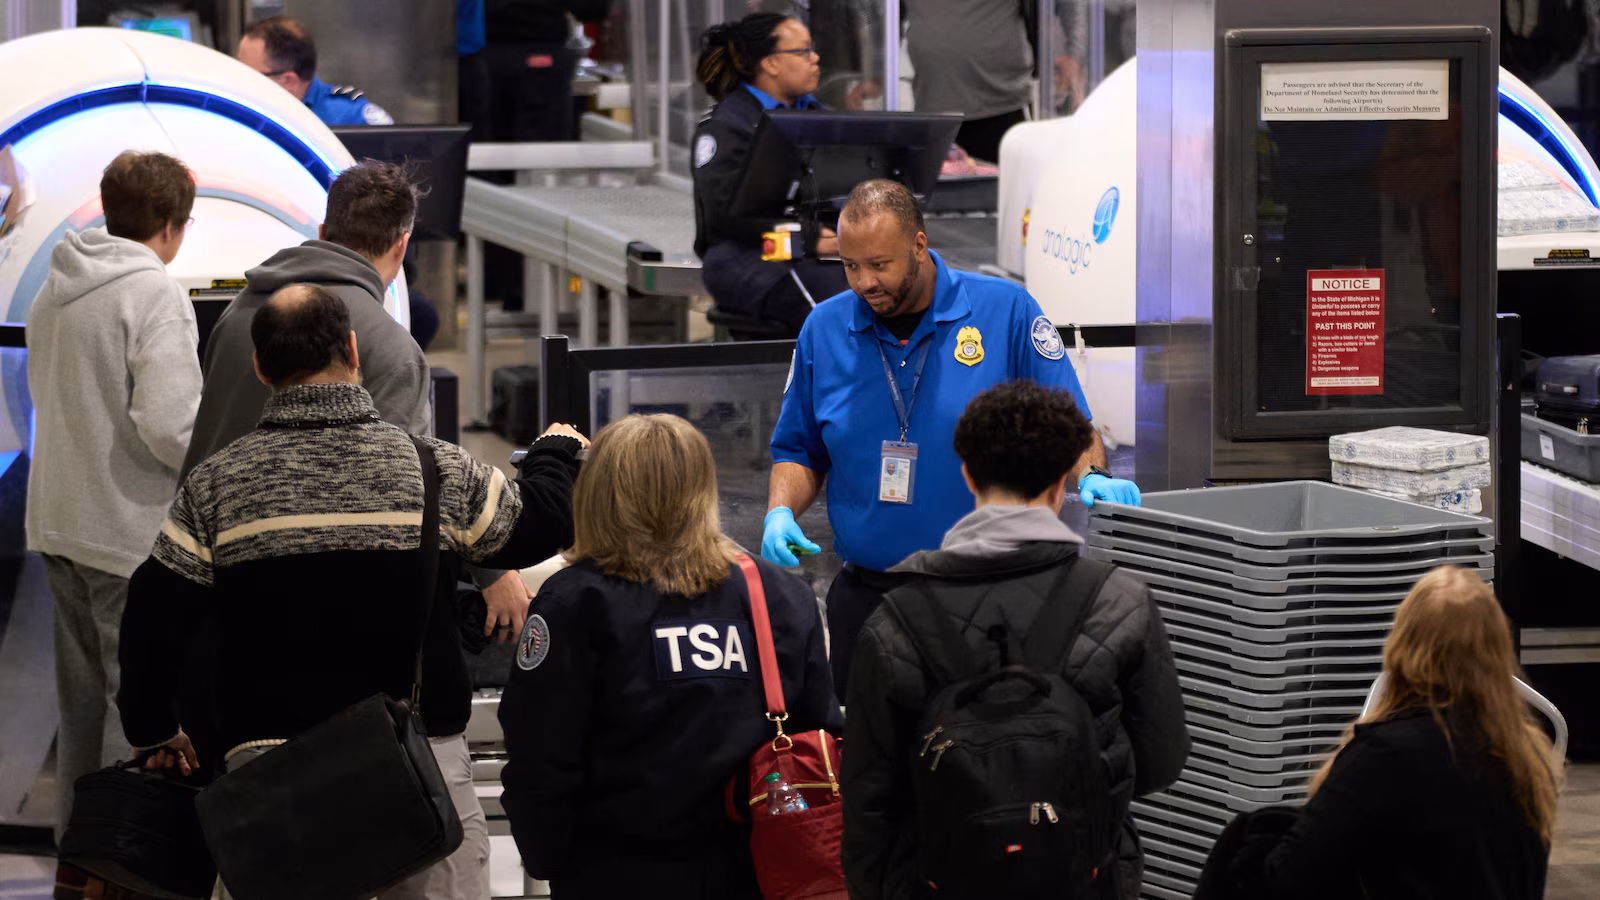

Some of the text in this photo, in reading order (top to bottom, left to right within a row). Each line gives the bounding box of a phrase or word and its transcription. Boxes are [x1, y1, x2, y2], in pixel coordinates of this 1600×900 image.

[1043, 226, 1092, 274] analogic
[1322, 280, 1370, 289] NOTICE
[656, 624, 748, 672] TSA
